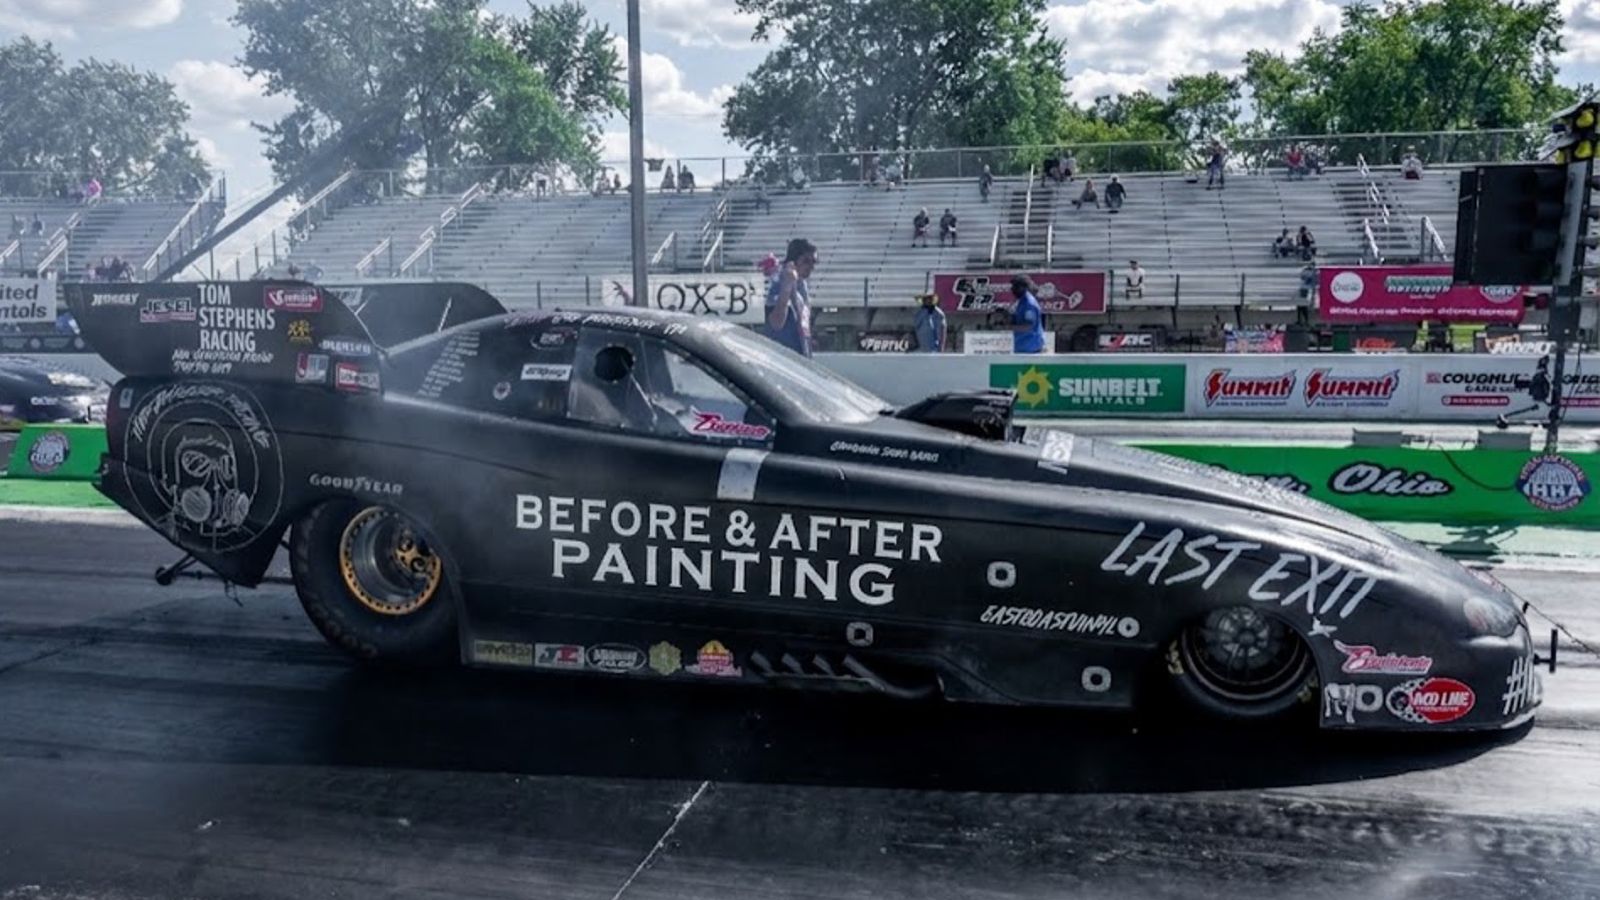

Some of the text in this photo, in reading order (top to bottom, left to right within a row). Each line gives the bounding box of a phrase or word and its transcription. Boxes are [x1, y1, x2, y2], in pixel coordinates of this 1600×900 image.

[198, 284, 231, 305] TOM
[199, 307, 277, 330] STEPHENS
[201, 330, 256, 352] RACING
[1332, 463, 1449, 495] Ohio
[515, 494, 943, 563] BEFORE & AFTER
[1101, 521, 1262, 590] LAST
[551, 538, 896, 606] PAINTING
